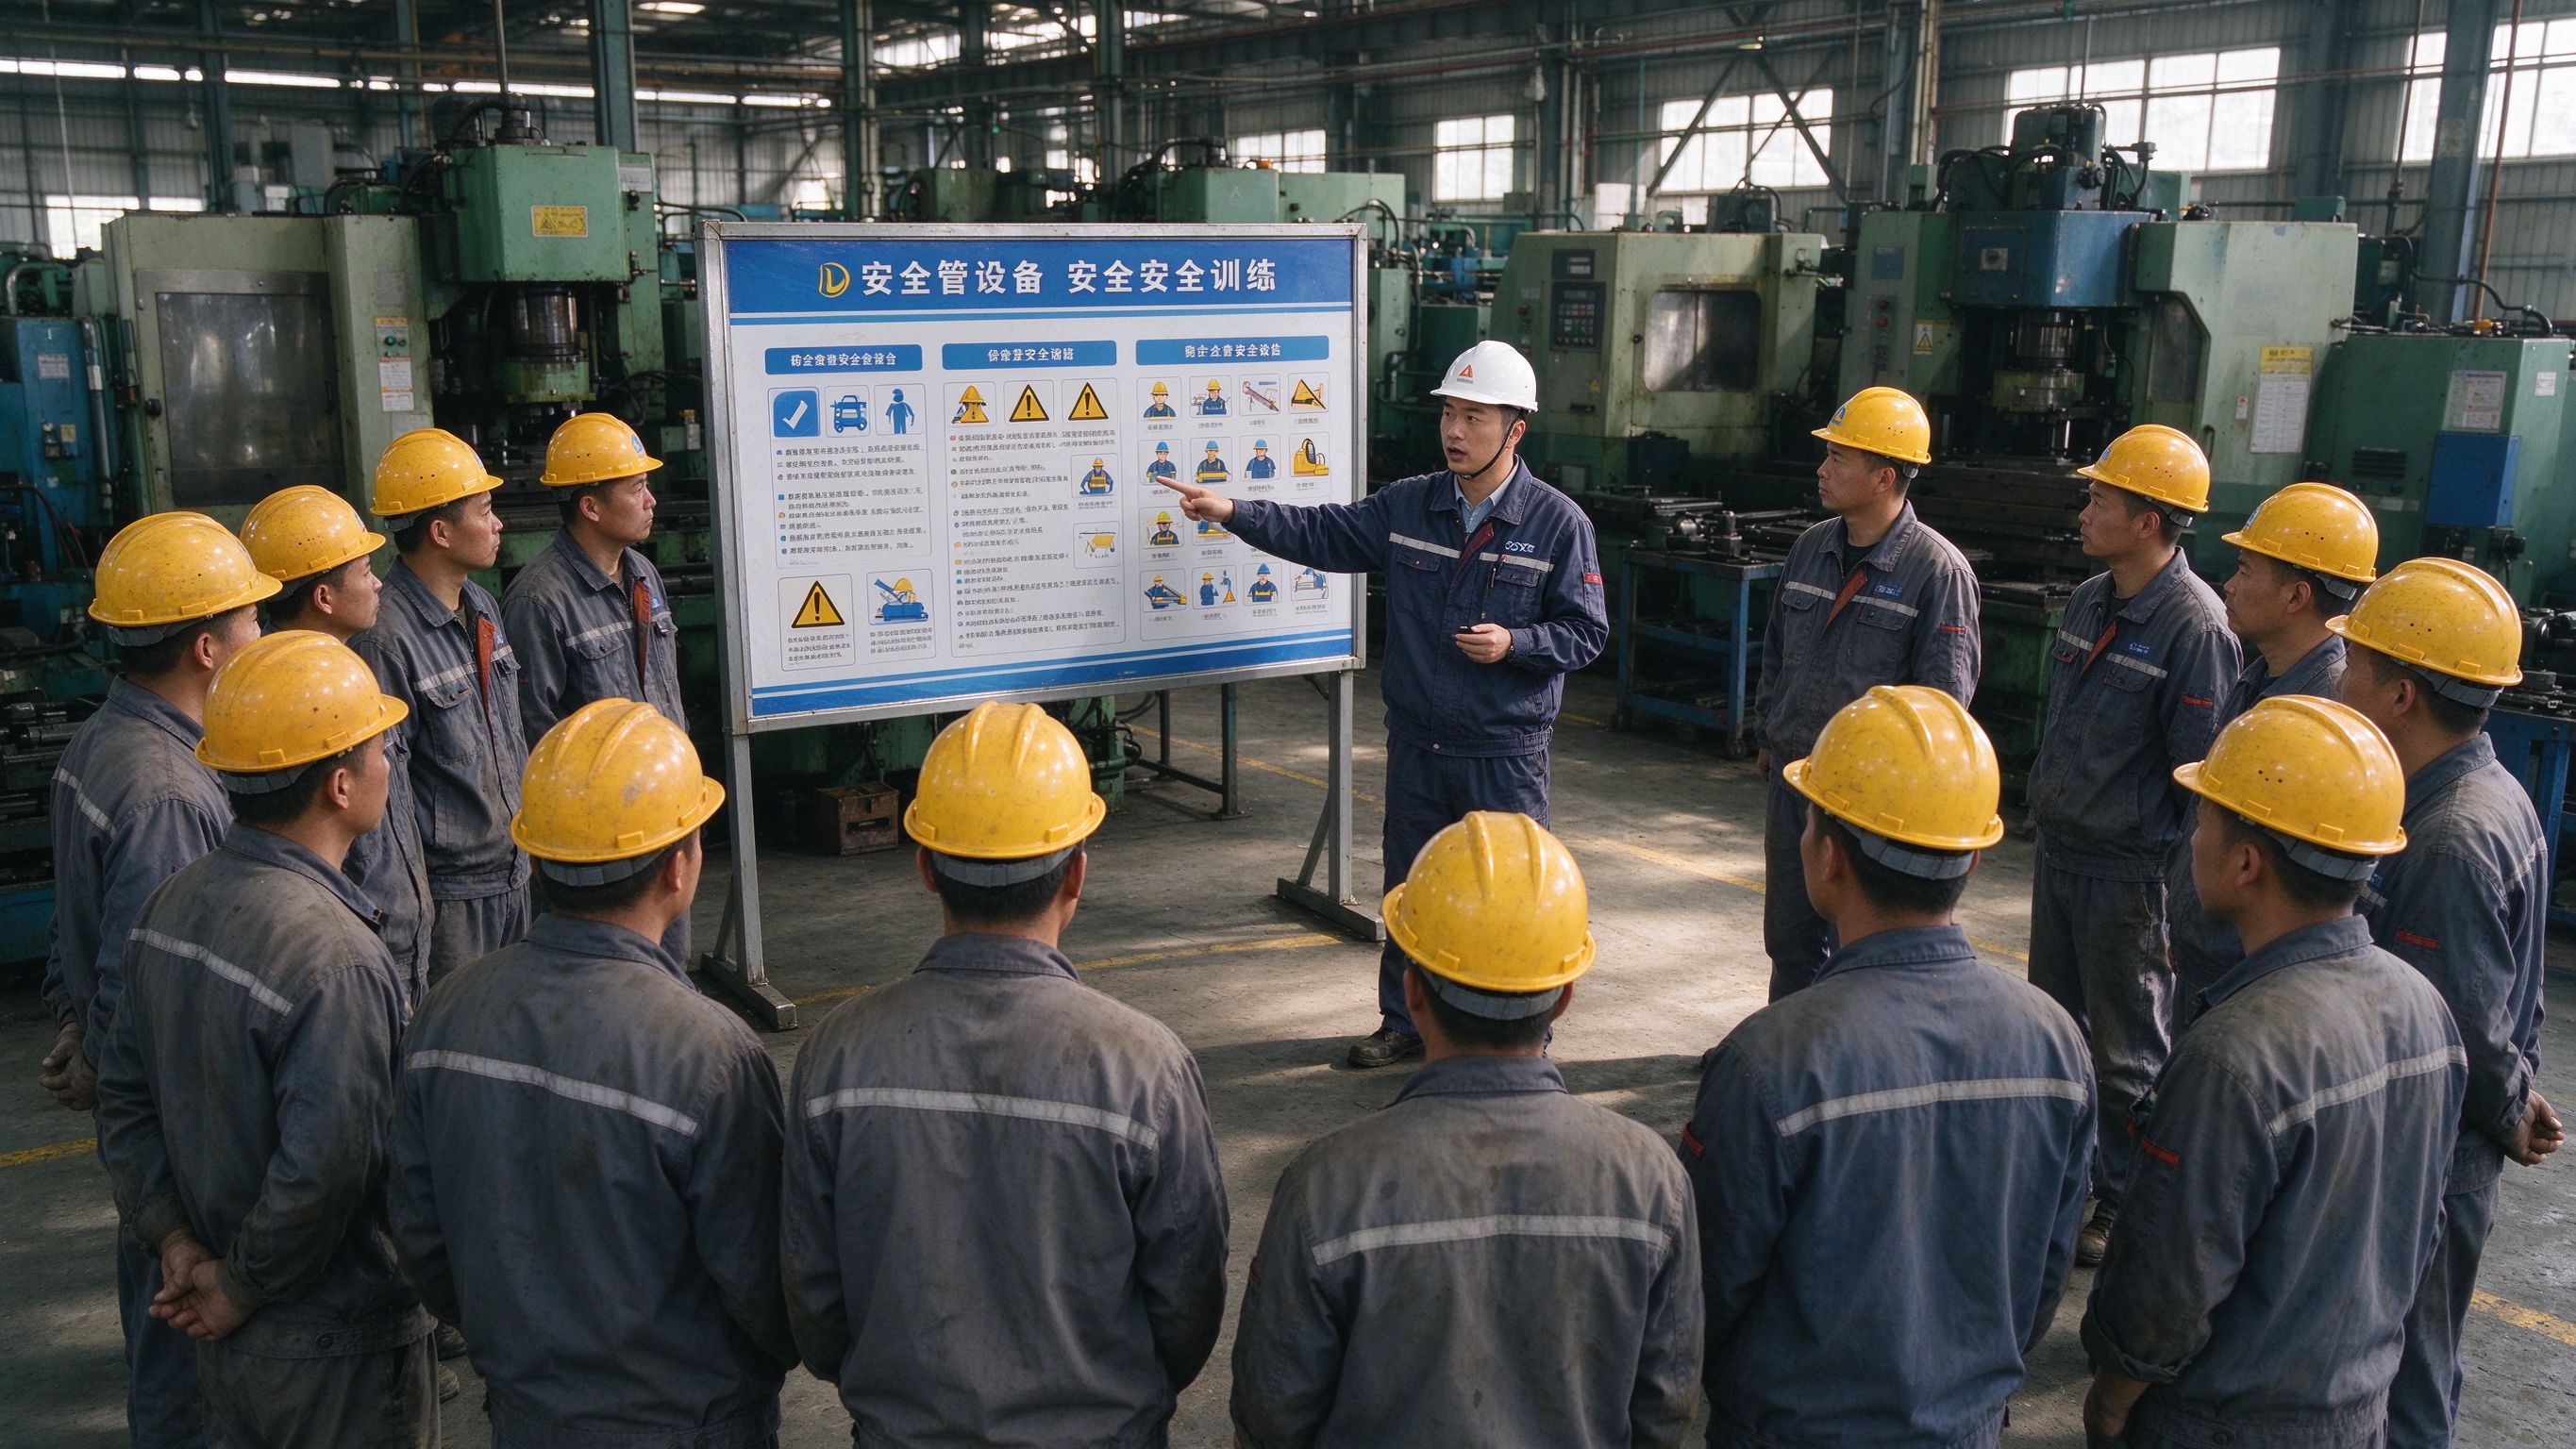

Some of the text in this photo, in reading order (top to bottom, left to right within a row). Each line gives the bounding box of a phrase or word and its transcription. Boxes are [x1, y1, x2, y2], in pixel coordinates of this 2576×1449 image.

[861, 259, 1043, 296] 安全管设备
